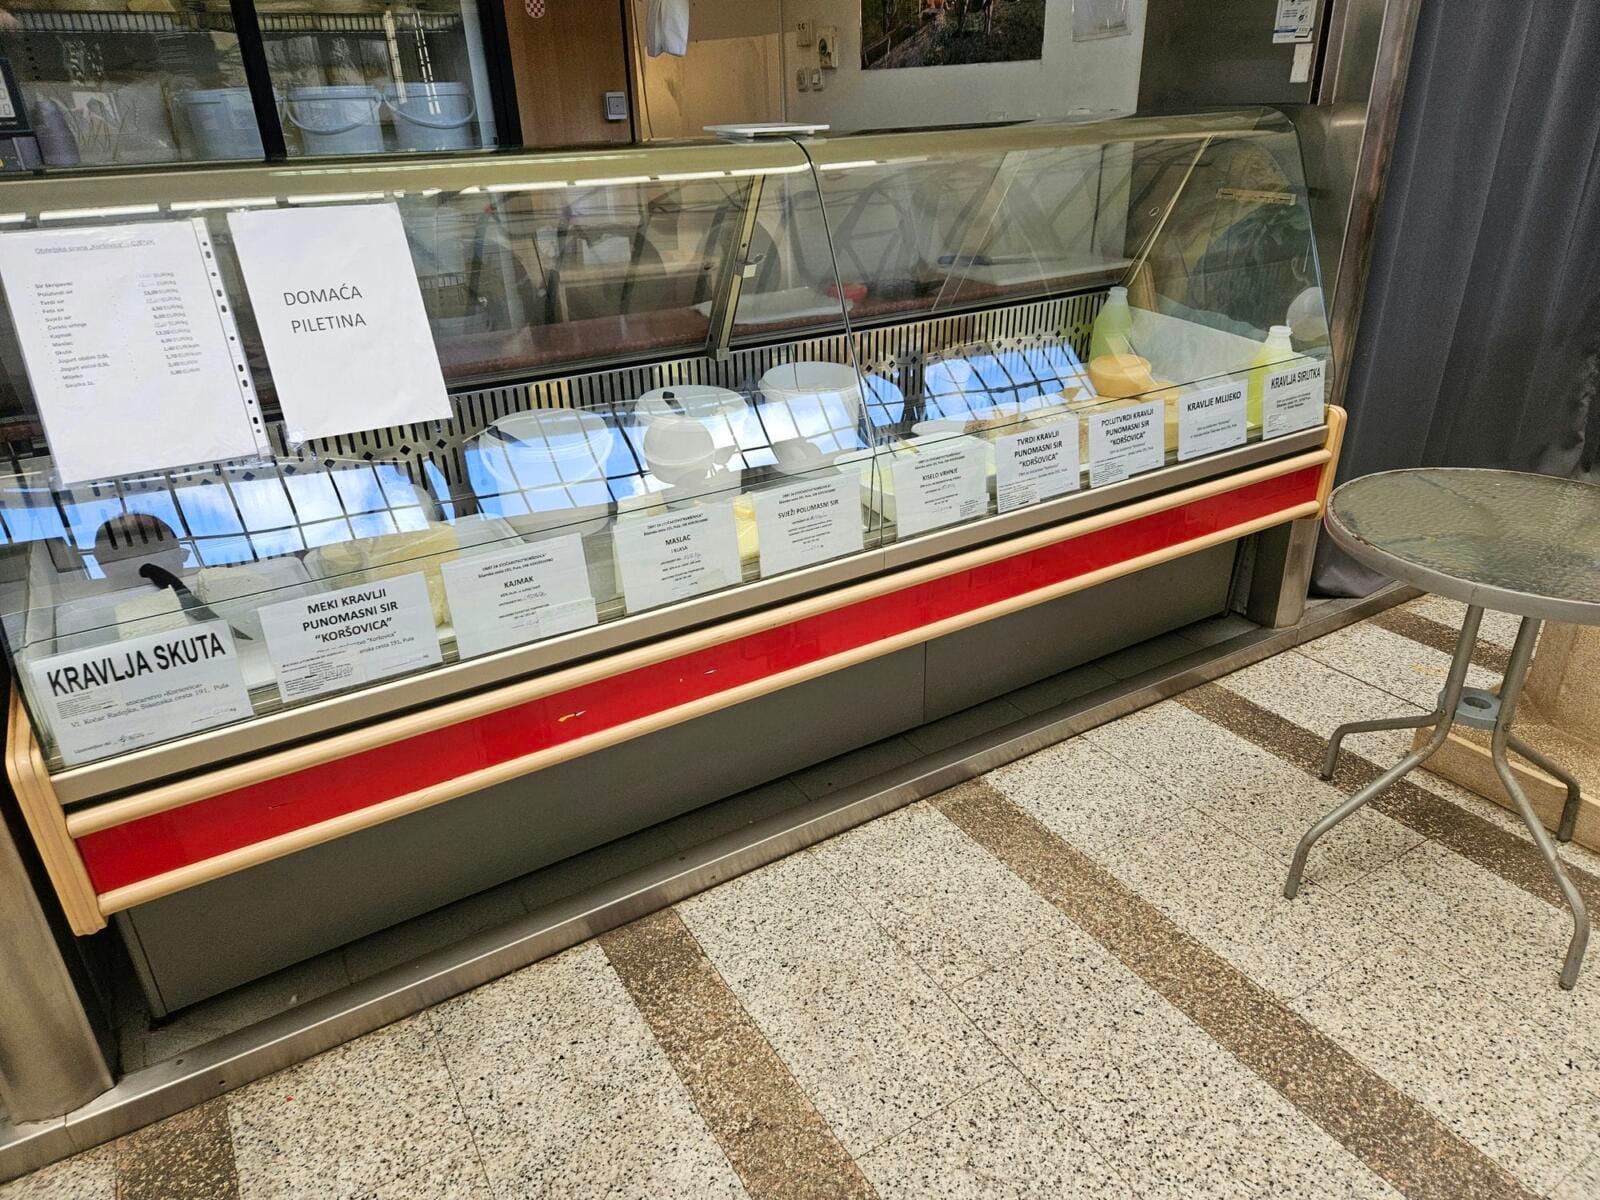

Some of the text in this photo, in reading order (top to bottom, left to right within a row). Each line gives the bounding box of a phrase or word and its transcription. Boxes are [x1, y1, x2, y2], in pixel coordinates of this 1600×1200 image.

[283, 283, 363, 306] DOMAĆA
[291, 312, 367, 334] PILETINA
[1187, 390, 1242, 412] KRAVLJE MLIJEKO
[1101, 408, 1154, 427] POLUTVRDI KRAVLJI
[1106, 420, 1150, 437] PUNOMASNI SIR
[1016, 430, 1060, 446] TVRDI KRAVLJI
[1014, 440, 1063, 458] PUNOMASNI SIR
[922, 472, 939, 481] KISELO
[796, 501, 829, 514] POLUMASNI
[830, 499, 839, 507] SIR
[665, 534, 691, 546] MASLAC
[504, 575, 534, 589] KAJMAK
[307, 587, 387, 615] MEKI KRAVLJI
[302, 600, 399, 632] PUNOMASNI SIR
[47, 632, 227, 697] KRAVLJA SKUTA
